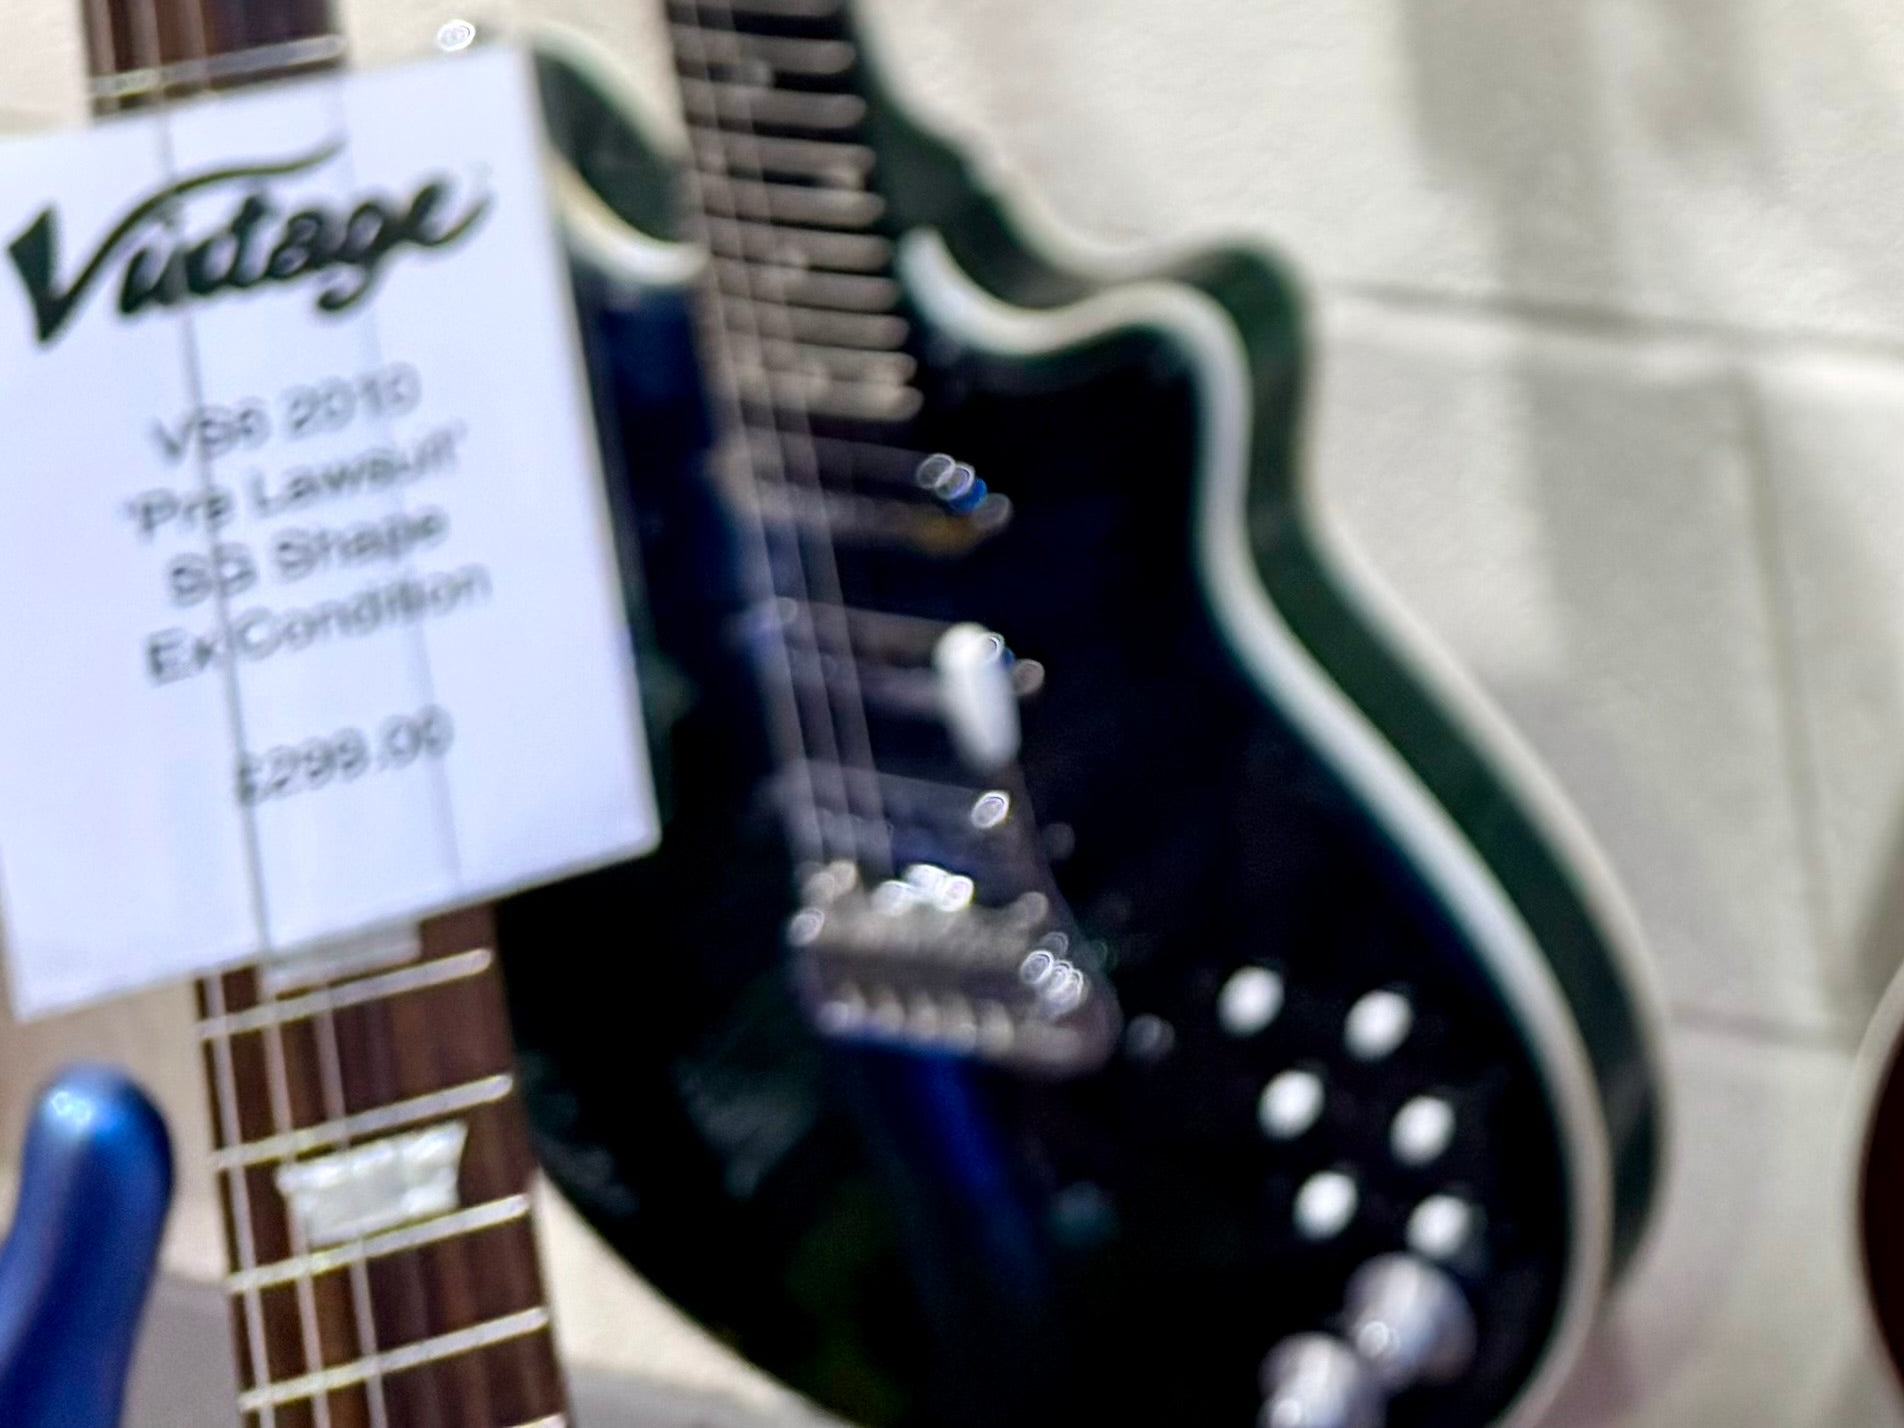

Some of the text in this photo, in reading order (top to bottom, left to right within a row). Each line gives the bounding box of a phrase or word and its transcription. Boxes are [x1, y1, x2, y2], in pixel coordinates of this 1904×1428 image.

[3, 138, 490, 346] Vintage
[278, 361, 424, 441] 2010
[270, 504, 452, 584] Shape
[233, 561, 495, 662] Condition
